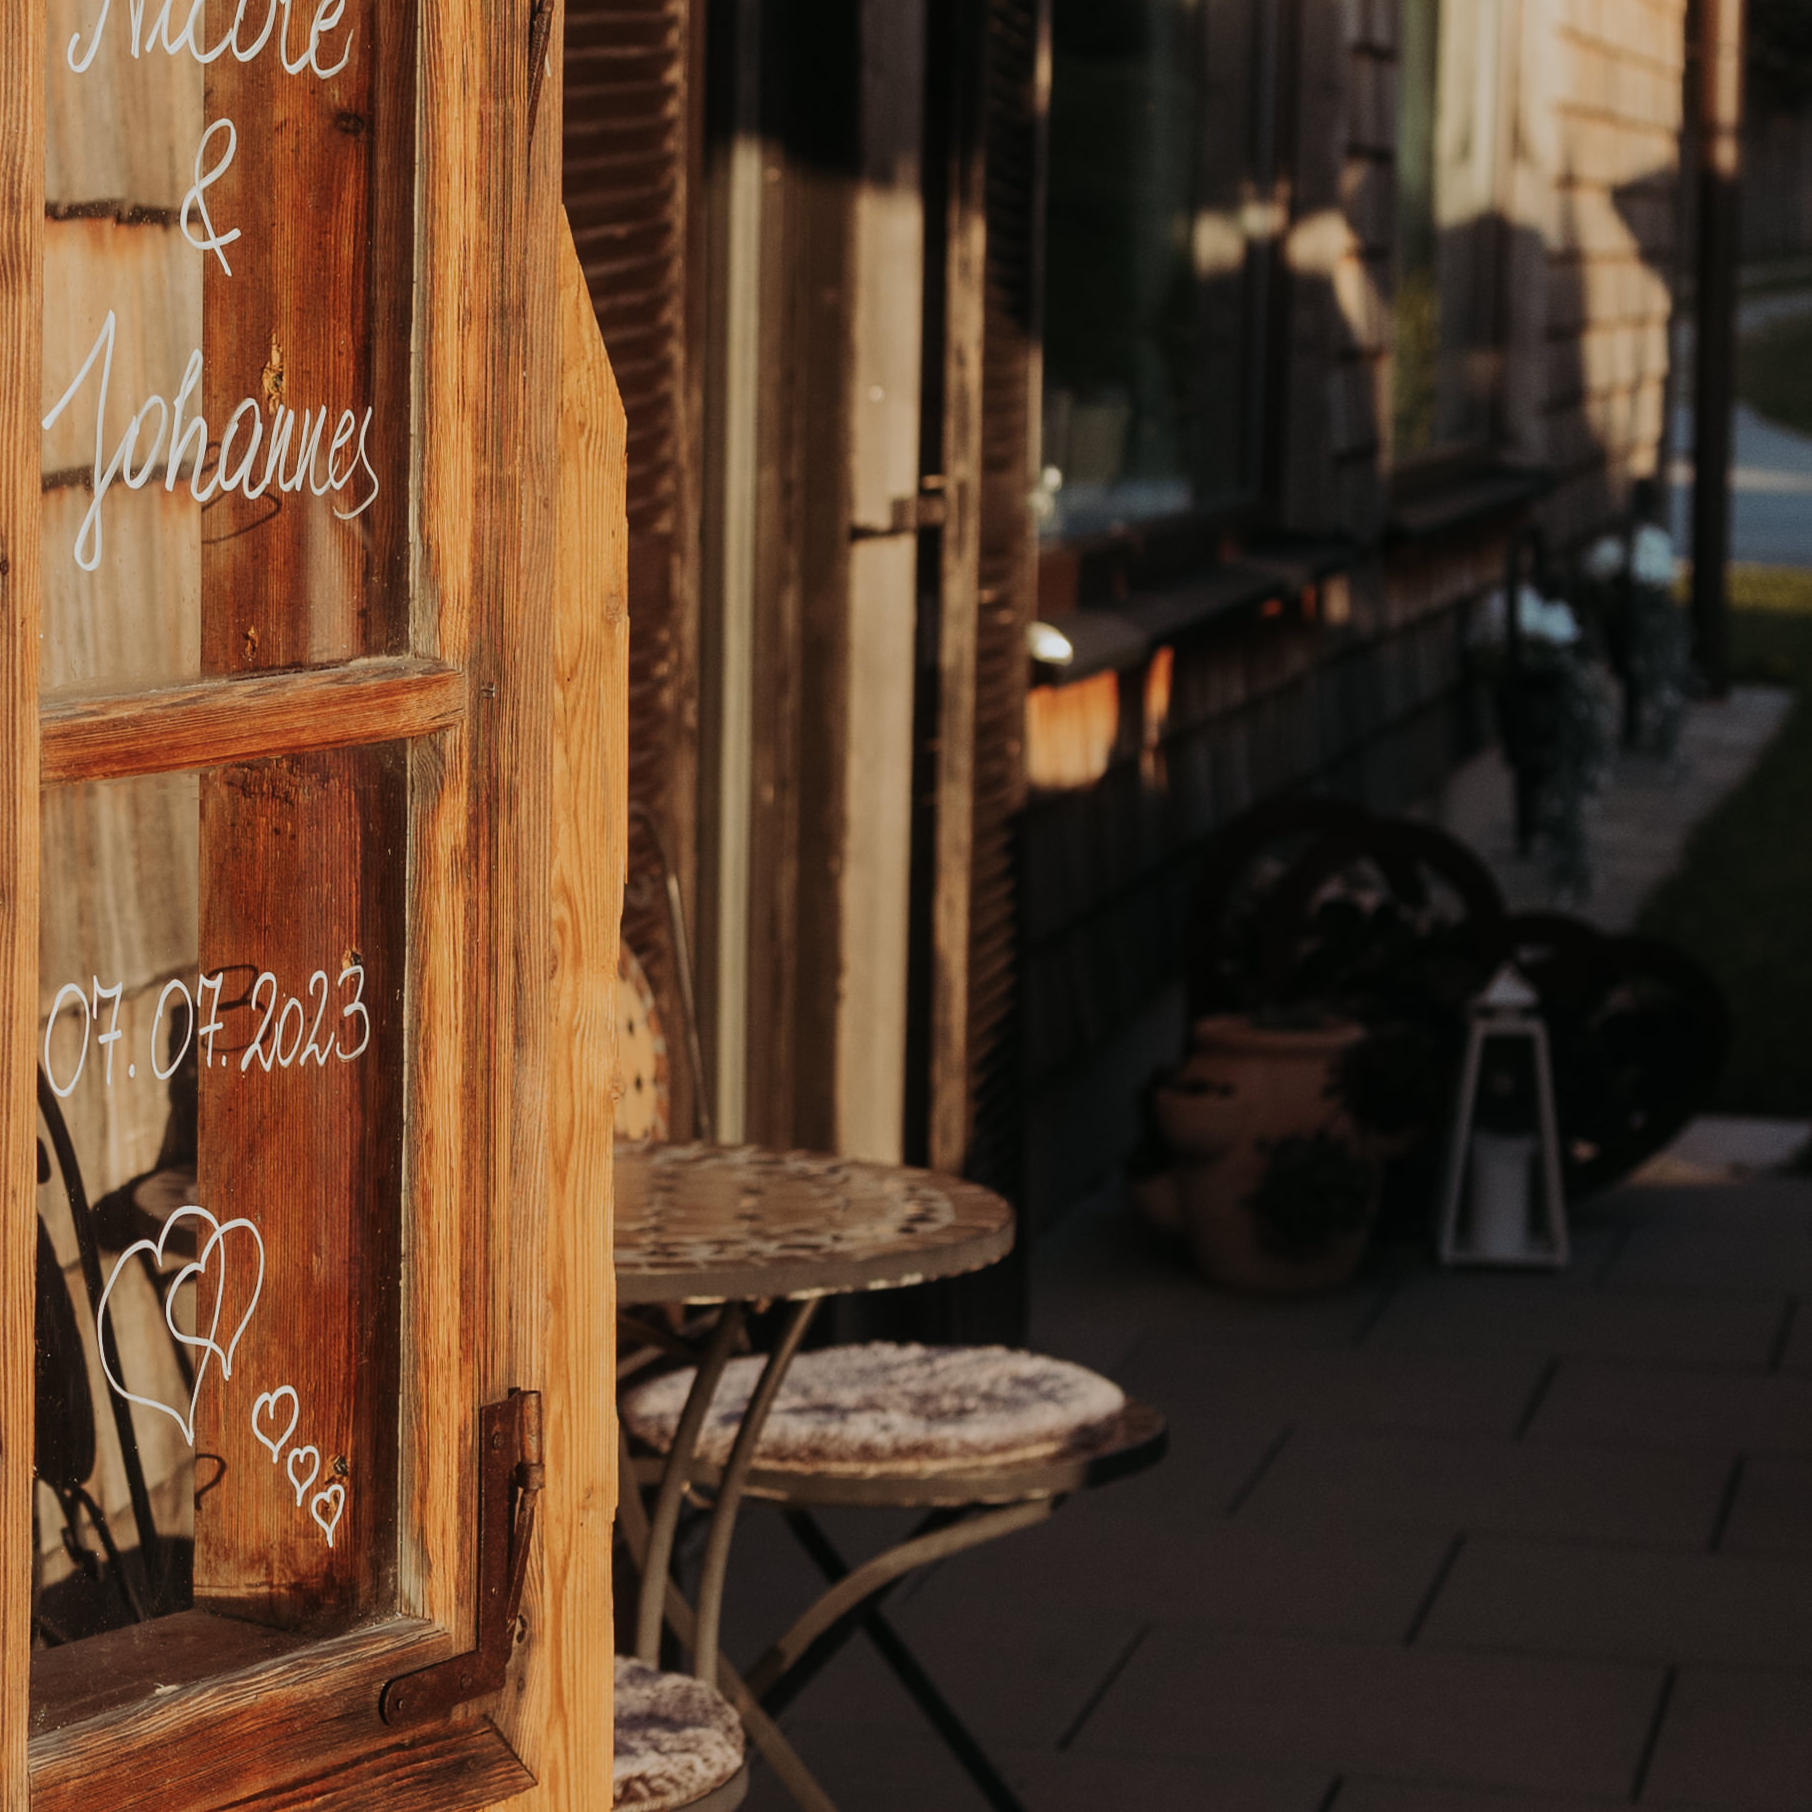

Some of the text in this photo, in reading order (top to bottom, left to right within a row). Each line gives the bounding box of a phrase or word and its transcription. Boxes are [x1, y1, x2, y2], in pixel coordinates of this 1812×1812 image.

[179, 118, 242, 277] &
[41, 309, 380, 572] Johannes
[43, 964, 371, 1097] 07.07.2023
